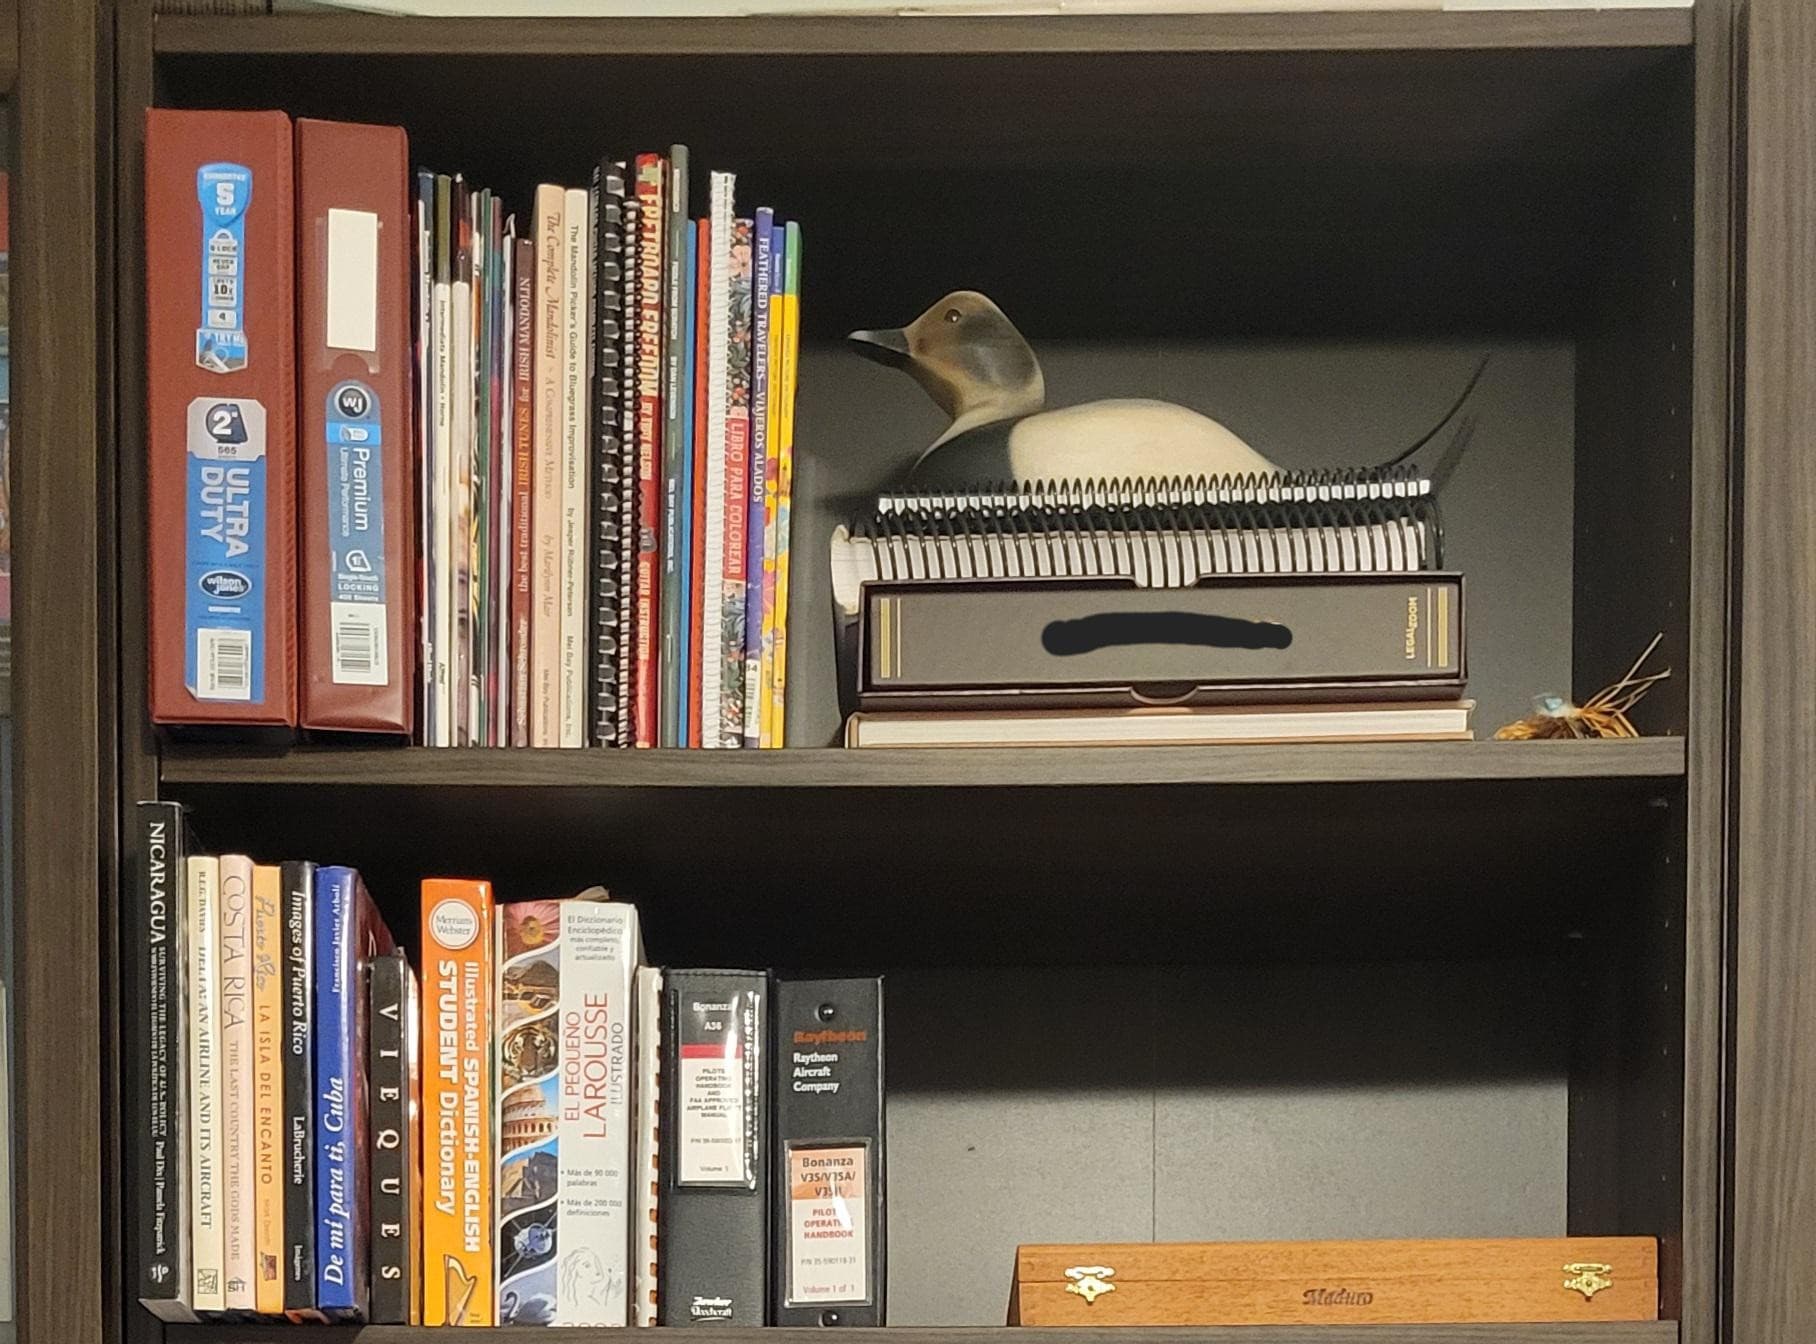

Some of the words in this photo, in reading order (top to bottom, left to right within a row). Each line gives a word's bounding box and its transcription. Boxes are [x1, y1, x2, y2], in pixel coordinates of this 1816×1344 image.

[569, 225, 579, 242] The
[569, 245, 579, 290] Mandolin
[756, 238, 770, 307] FEATHERED
[569, 292, 579, 328] Picker's
[569, 331, 579, 356] Guide
[569, 359, 579, 370] to
[567, 374, 577, 419] Bluegrass
[567, 423, 576, 488] Improvisation
[727, 424, 744, 461] LIBRO
[353, 447, 370, 530] Premium
[727, 469, 744, 501] PARA
[753, 452, 764, 502] ALADOS
[200, 466, 223, 543] DUTY
[226, 468, 249, 558] ULTRA
[727, 505, 744, 575] COLOREAR
[1405, 596, 1418, 660] LEGALZOOM
[150, 823, 165, 943] NICARAGUA
[290, 891, 307, 943] Images
[290, 948, 307, 962] of
[290, 966, 307, 1017] Puerto
[464, 962, 479, 1051] Illustrated
[290, 1021, 307, 1054] Rico
[437, 961, 458, 1083] STUDENT
[584, 993, 608, 1138] LAROUSSE
[611, 1022, 624, 1104] ILUSTRADO
[793, 1053, 838, 1065] Raytheon
[794, 1066, 831, 1078] Aircraft
[324, 1078, 344, 1133] Cuba
[794, 1080, 839, 1094] Company
[563, 1107, 580, 1120] EL
[292, 1116, 306, 1184] LaBrucherie
[379, 1001, 400, 1279] VIEQUES
[437, 1092, 458, 1215] Dictionary
[464, 1058, 479, 1252] SPANISH-ENGLISH
[802, 1156, 854, 1168] Bonanza
[324, 1168, 344, 1215] para
[804, 1230, 854, 1240] HANDBOOK
[324, 1254, 344, 1284] De
[1302, 1288, 1373, 1307] Maduro
